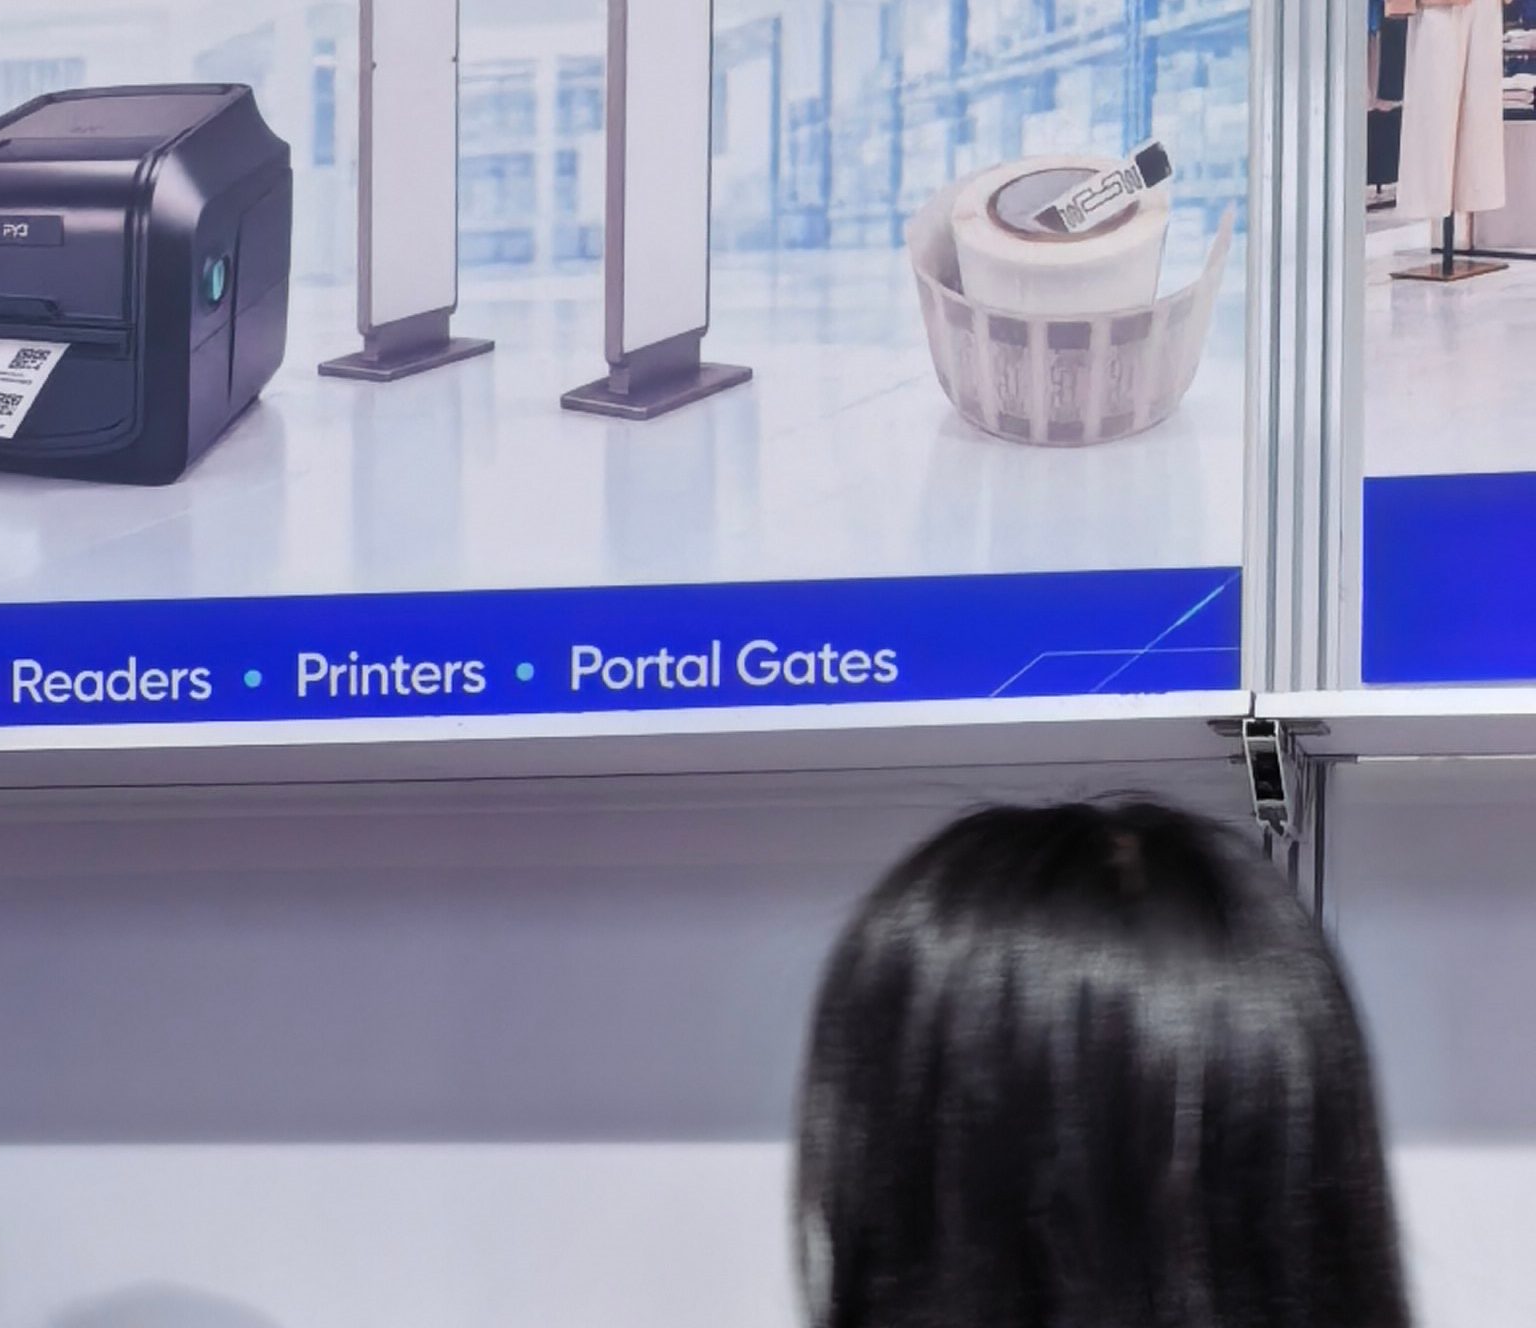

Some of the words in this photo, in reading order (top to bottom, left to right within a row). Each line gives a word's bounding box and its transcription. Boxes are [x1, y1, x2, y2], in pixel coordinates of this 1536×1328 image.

[11, 655, 213, 704] Readers
[297, 650, 487, 697] Printers
[570, 639, 721, 691] Portal
[735, 639, 899, 686] Gates
